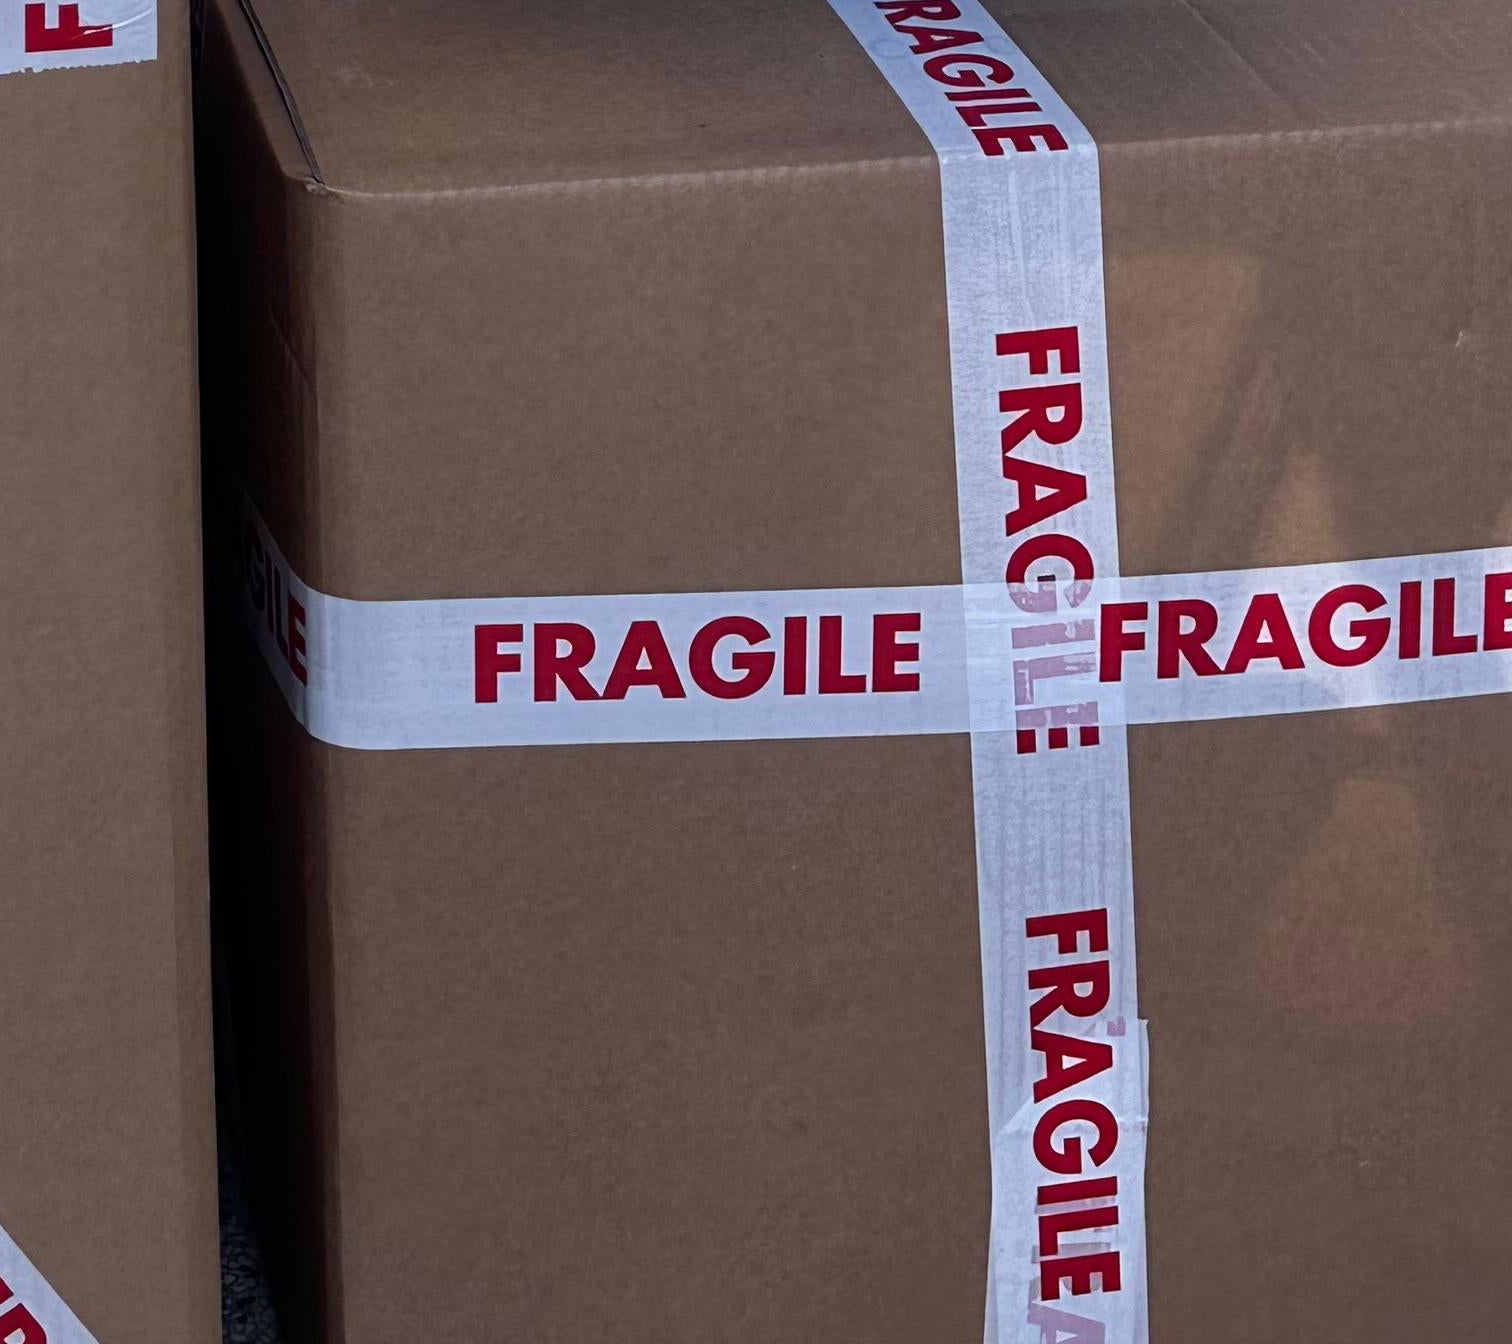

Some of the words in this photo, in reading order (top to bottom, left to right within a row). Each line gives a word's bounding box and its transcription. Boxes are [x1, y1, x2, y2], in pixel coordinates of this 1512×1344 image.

[474, 612, 922, 703] FRAGILE
[996, 326, 1100, 754] FRAGILE
[1025, 908, 1122, 1301] FRAGILE
